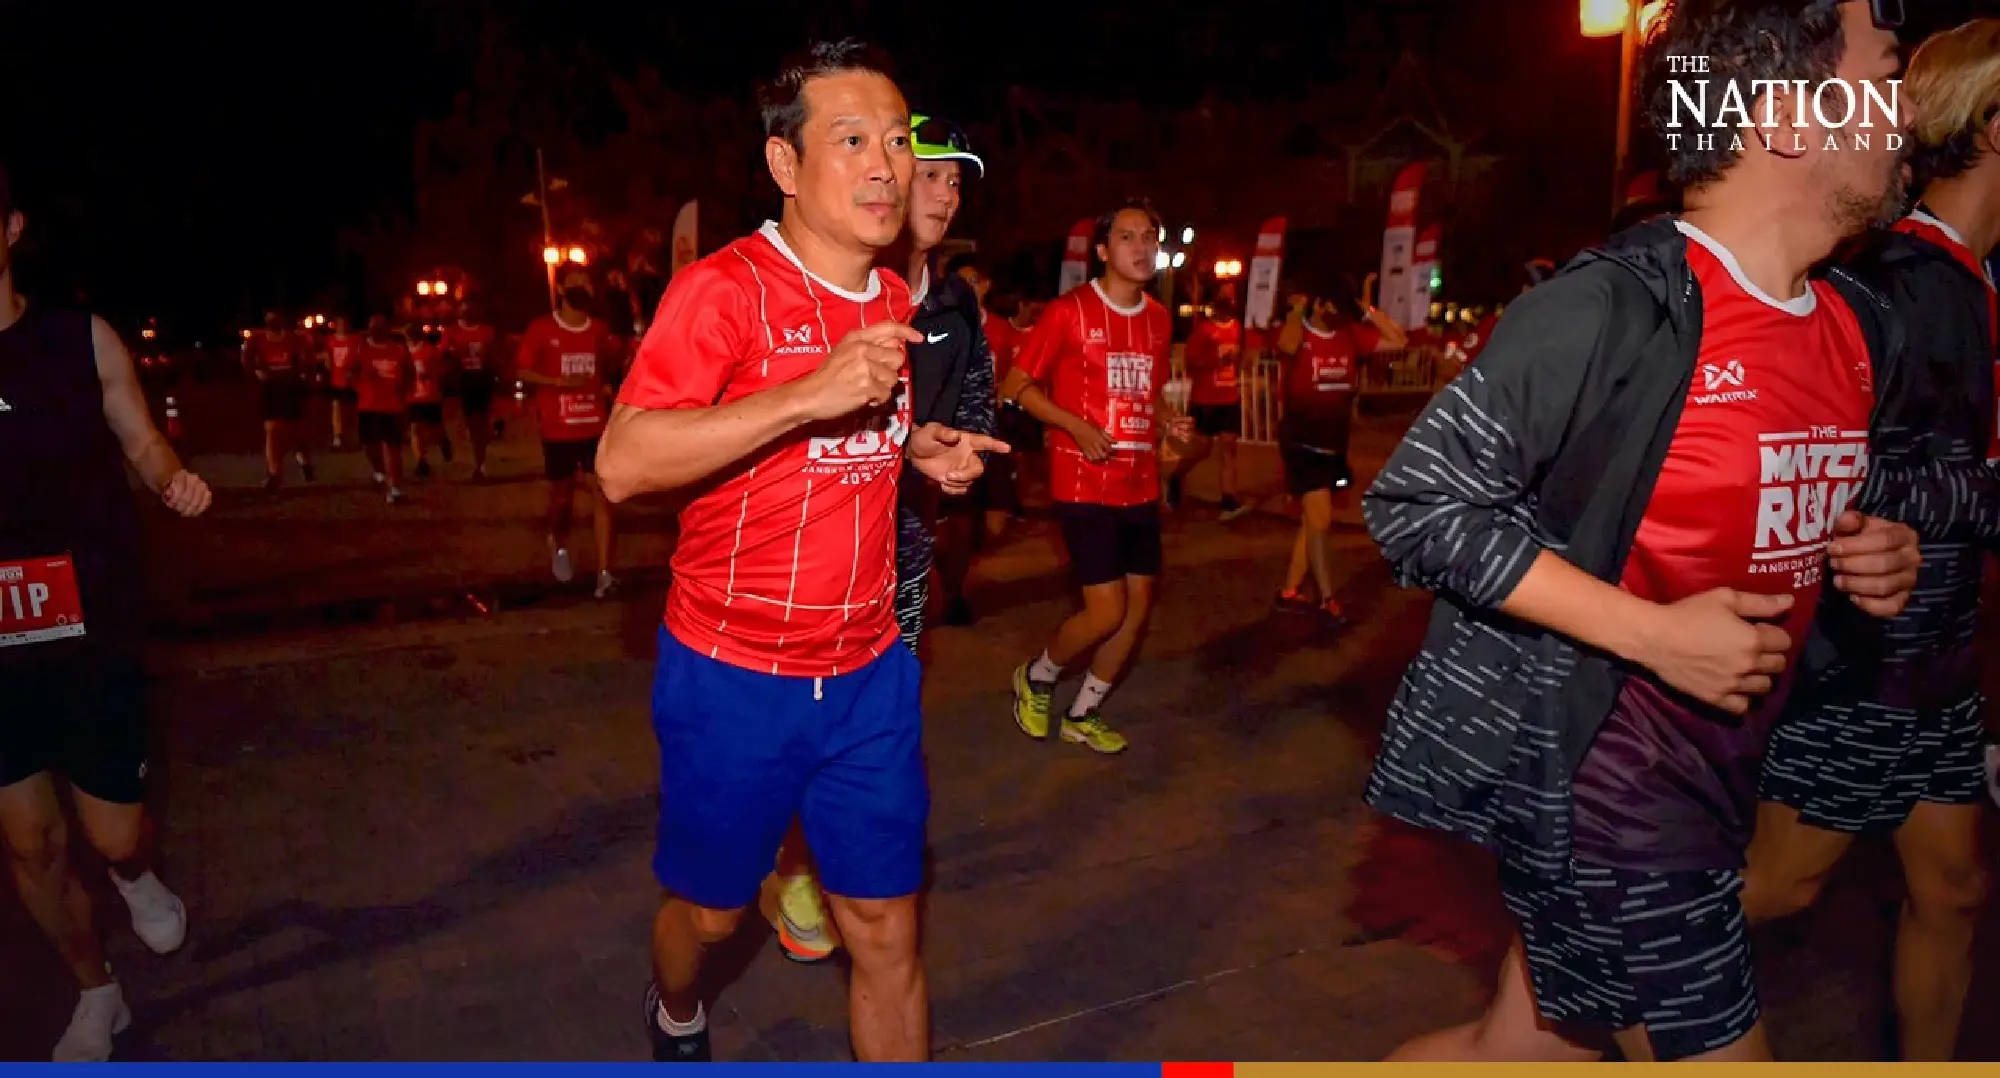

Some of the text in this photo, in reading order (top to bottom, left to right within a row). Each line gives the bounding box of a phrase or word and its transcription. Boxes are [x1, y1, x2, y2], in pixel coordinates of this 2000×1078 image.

[1694, 389, 1758, 405] WARRIX
[1810, 424, 1838, 439] THE
[0, 583, 49, 622] IP
